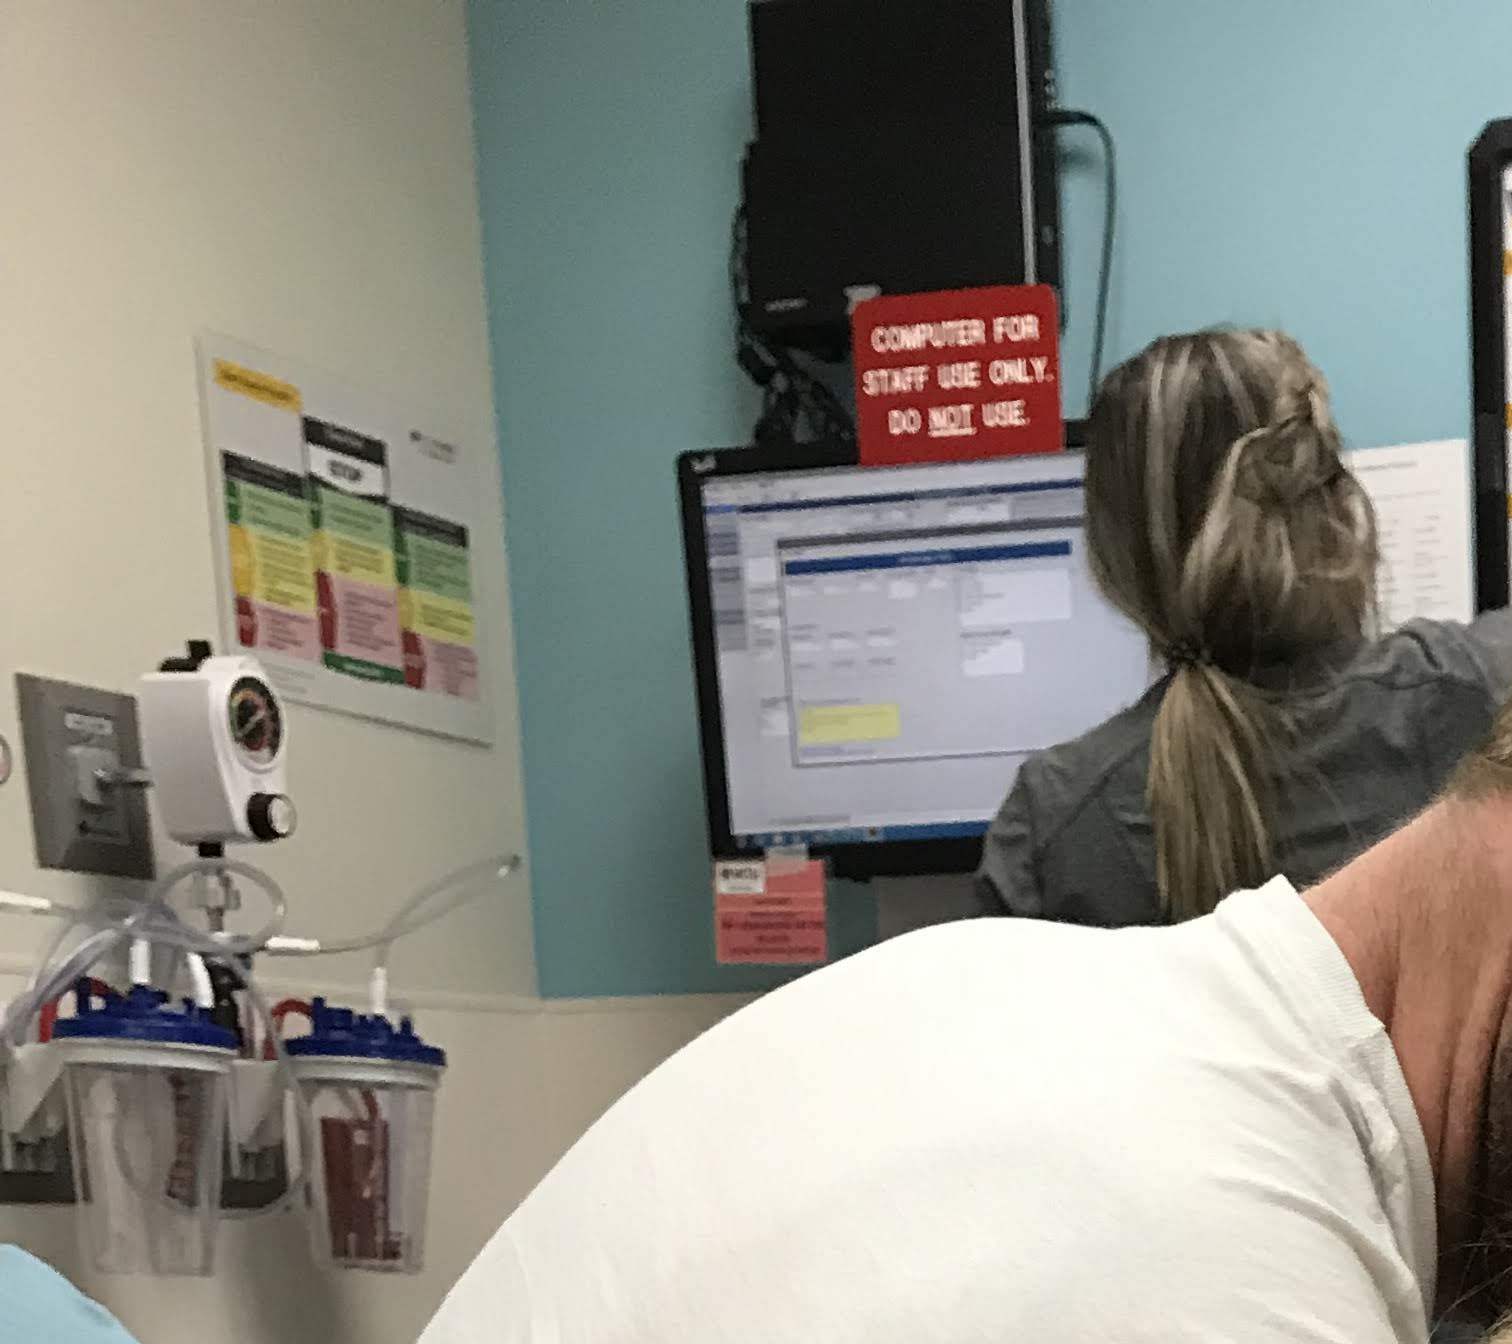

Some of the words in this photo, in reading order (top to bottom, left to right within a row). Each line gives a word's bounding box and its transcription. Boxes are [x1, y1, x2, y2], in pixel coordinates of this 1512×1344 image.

[871, 318, 986, 354] COMPUTER
[992, 313, 1041, 344] FOR
[861, 364, 930, 397] STAFF
[936, 360, 983, 390] USE
[988, 356, 1056, 386] ONLY.
[887, 407, 923, 436] DO
[927, 403, 976, 432] NOT
[981, 399, 1032, 428] USE.
